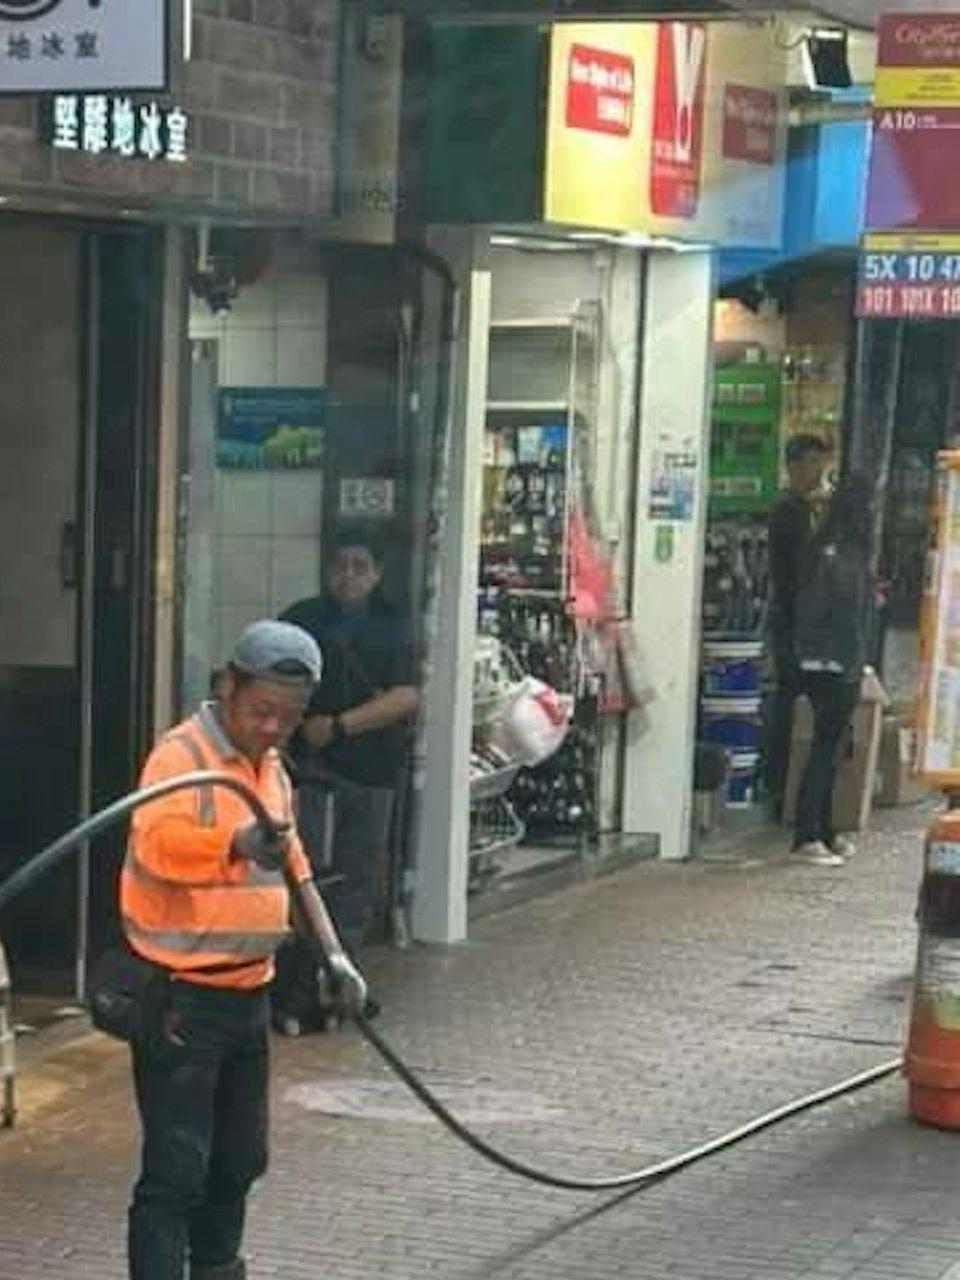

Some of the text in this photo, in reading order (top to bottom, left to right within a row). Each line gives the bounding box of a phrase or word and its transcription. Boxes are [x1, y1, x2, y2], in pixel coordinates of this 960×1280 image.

[880, 111, 916, 130] A10
[865, 253, 897, 279] 5X
[906, 254, 934, 280] 10
